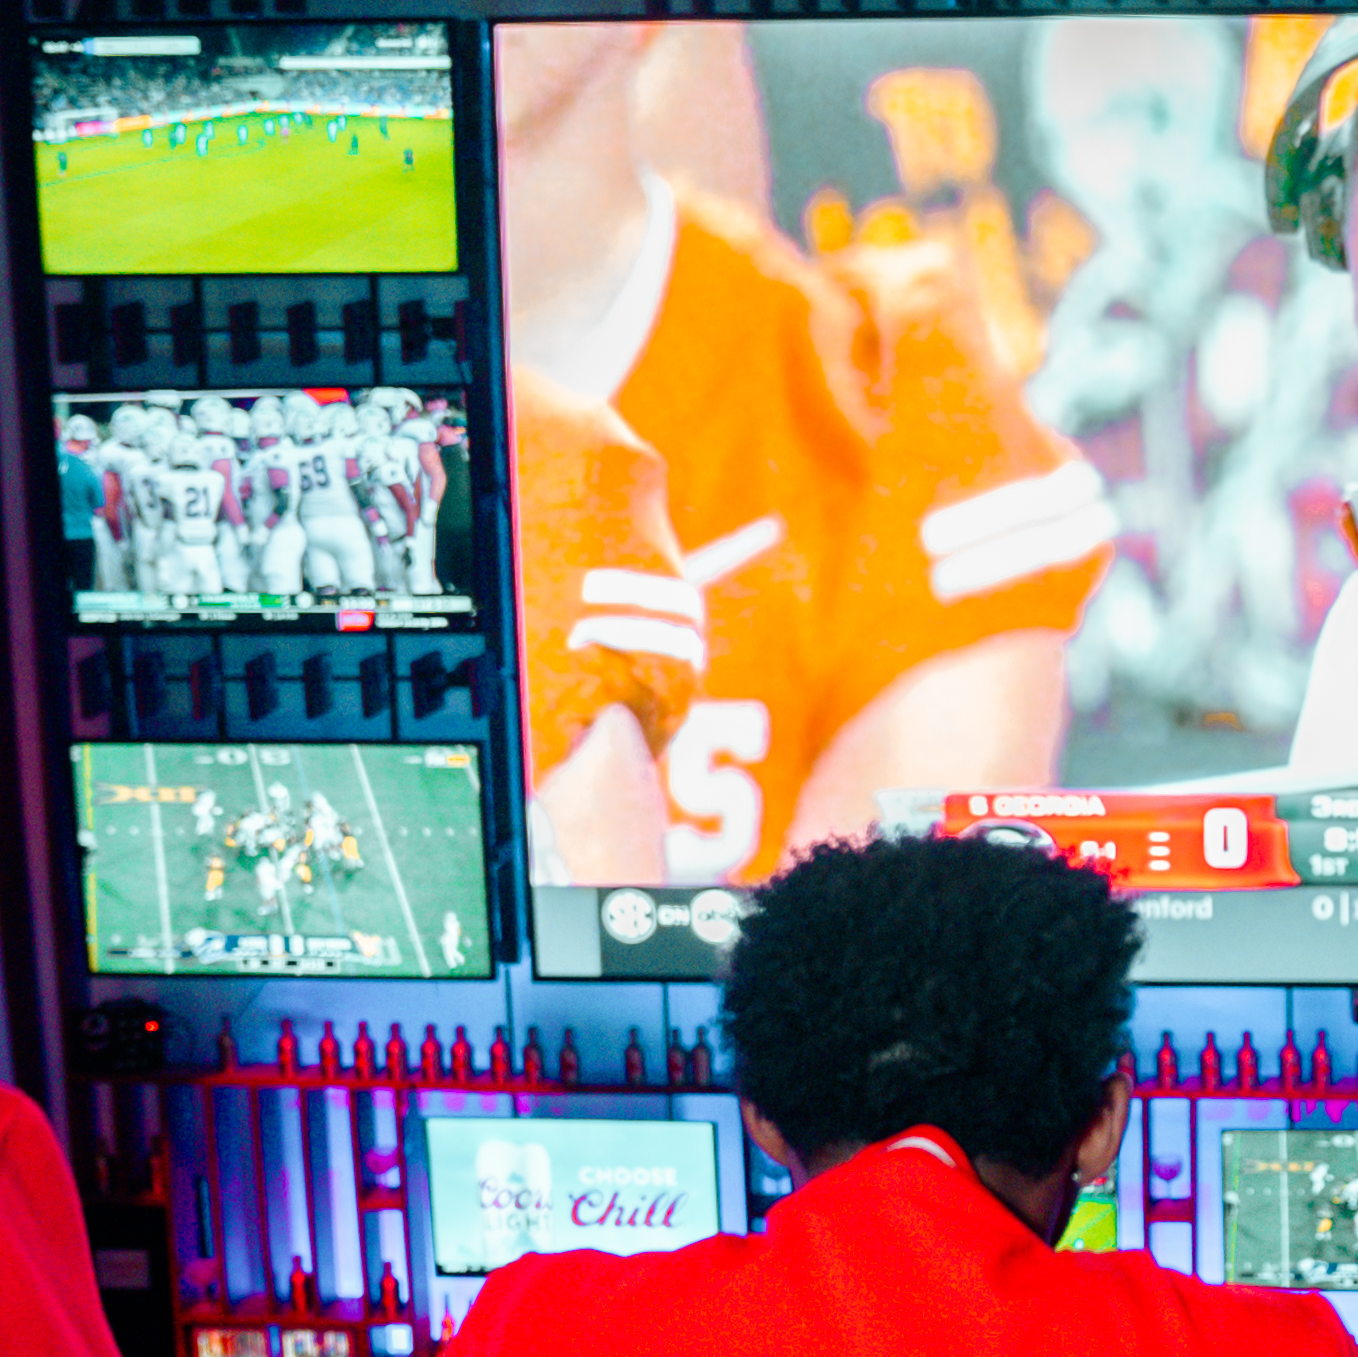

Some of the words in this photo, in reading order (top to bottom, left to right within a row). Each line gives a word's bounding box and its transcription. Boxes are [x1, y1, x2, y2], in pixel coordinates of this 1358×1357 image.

[1203, 807, 1249, 869] 0
[578, 1165, 679, 1187] CHOOSE
[568, 1190, 690, 1228] Chill
